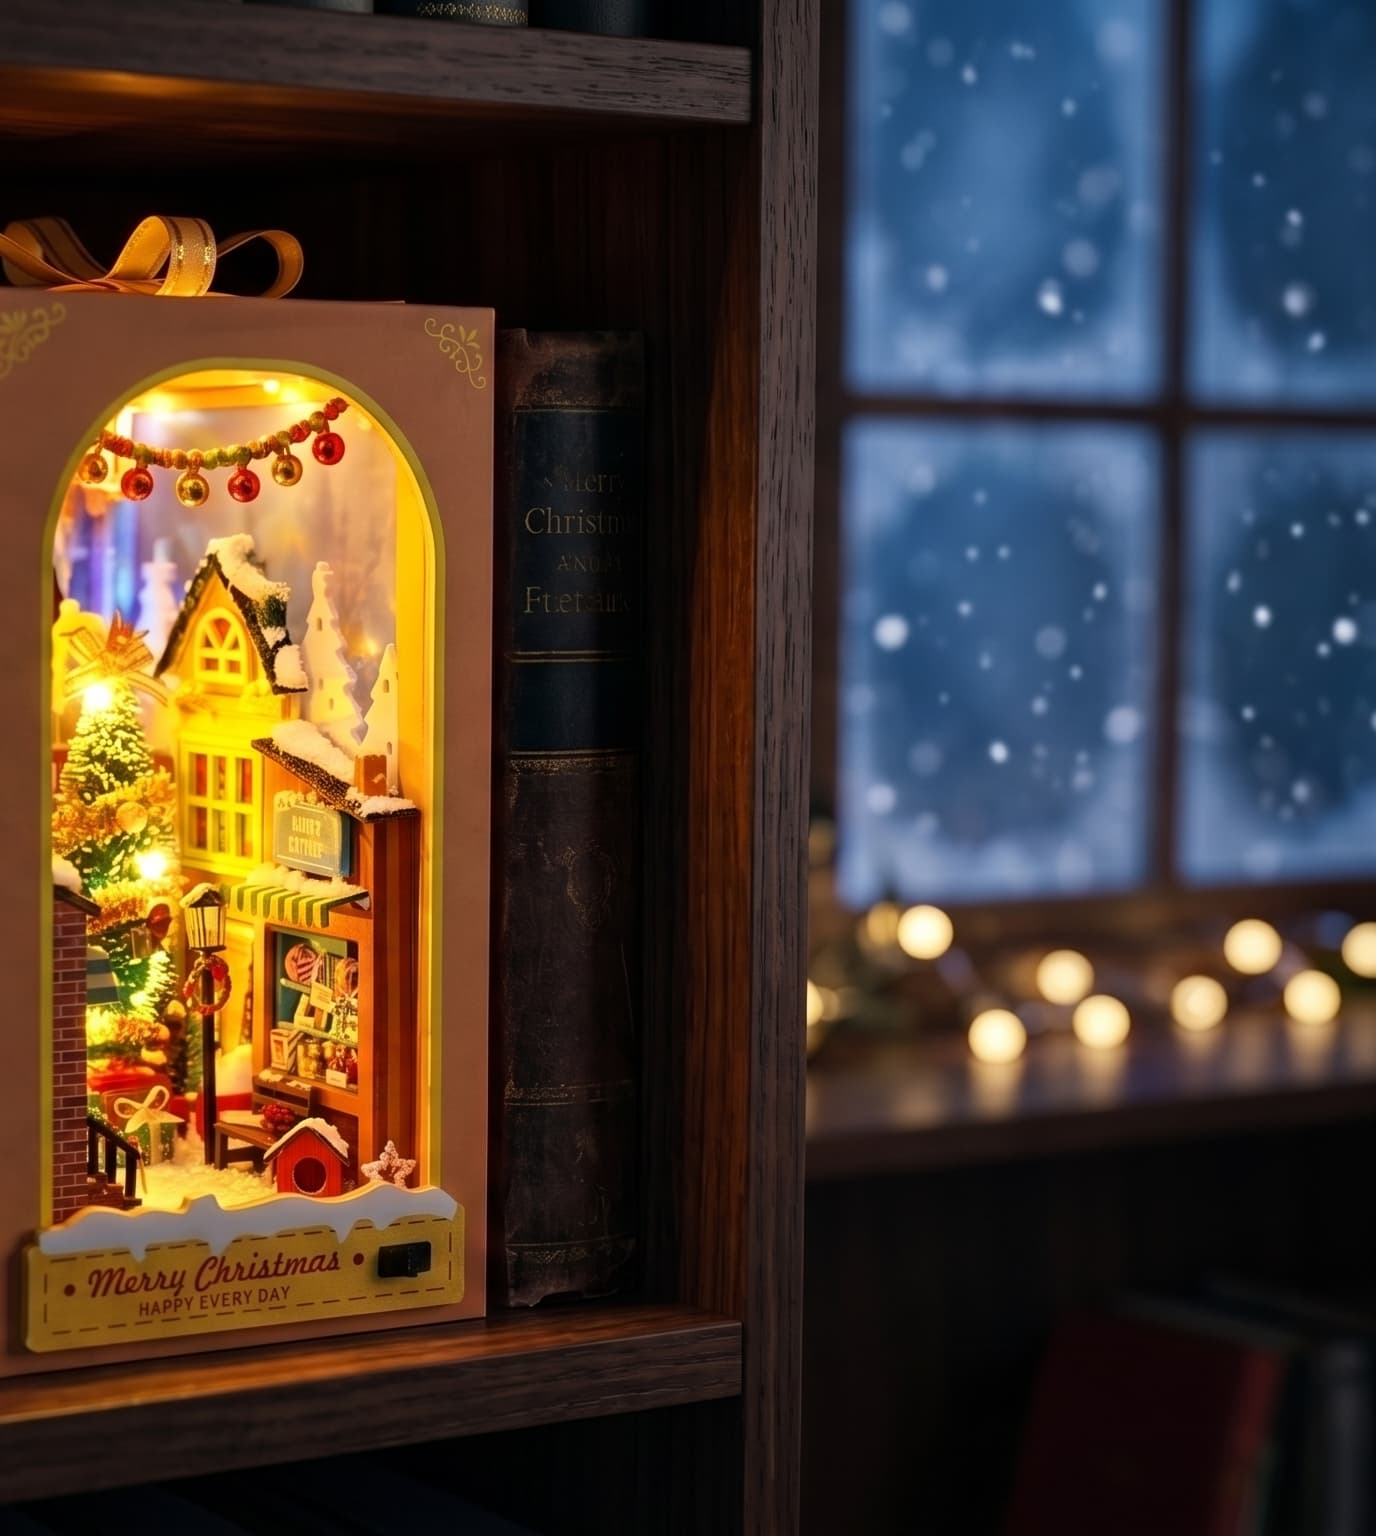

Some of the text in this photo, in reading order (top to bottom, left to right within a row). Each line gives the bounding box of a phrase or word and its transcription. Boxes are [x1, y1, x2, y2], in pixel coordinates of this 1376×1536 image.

[89, 1251, 340, 1297] Merry Christmas
[139, 1285, 291, 1317] HAPPY EVERY DAY
